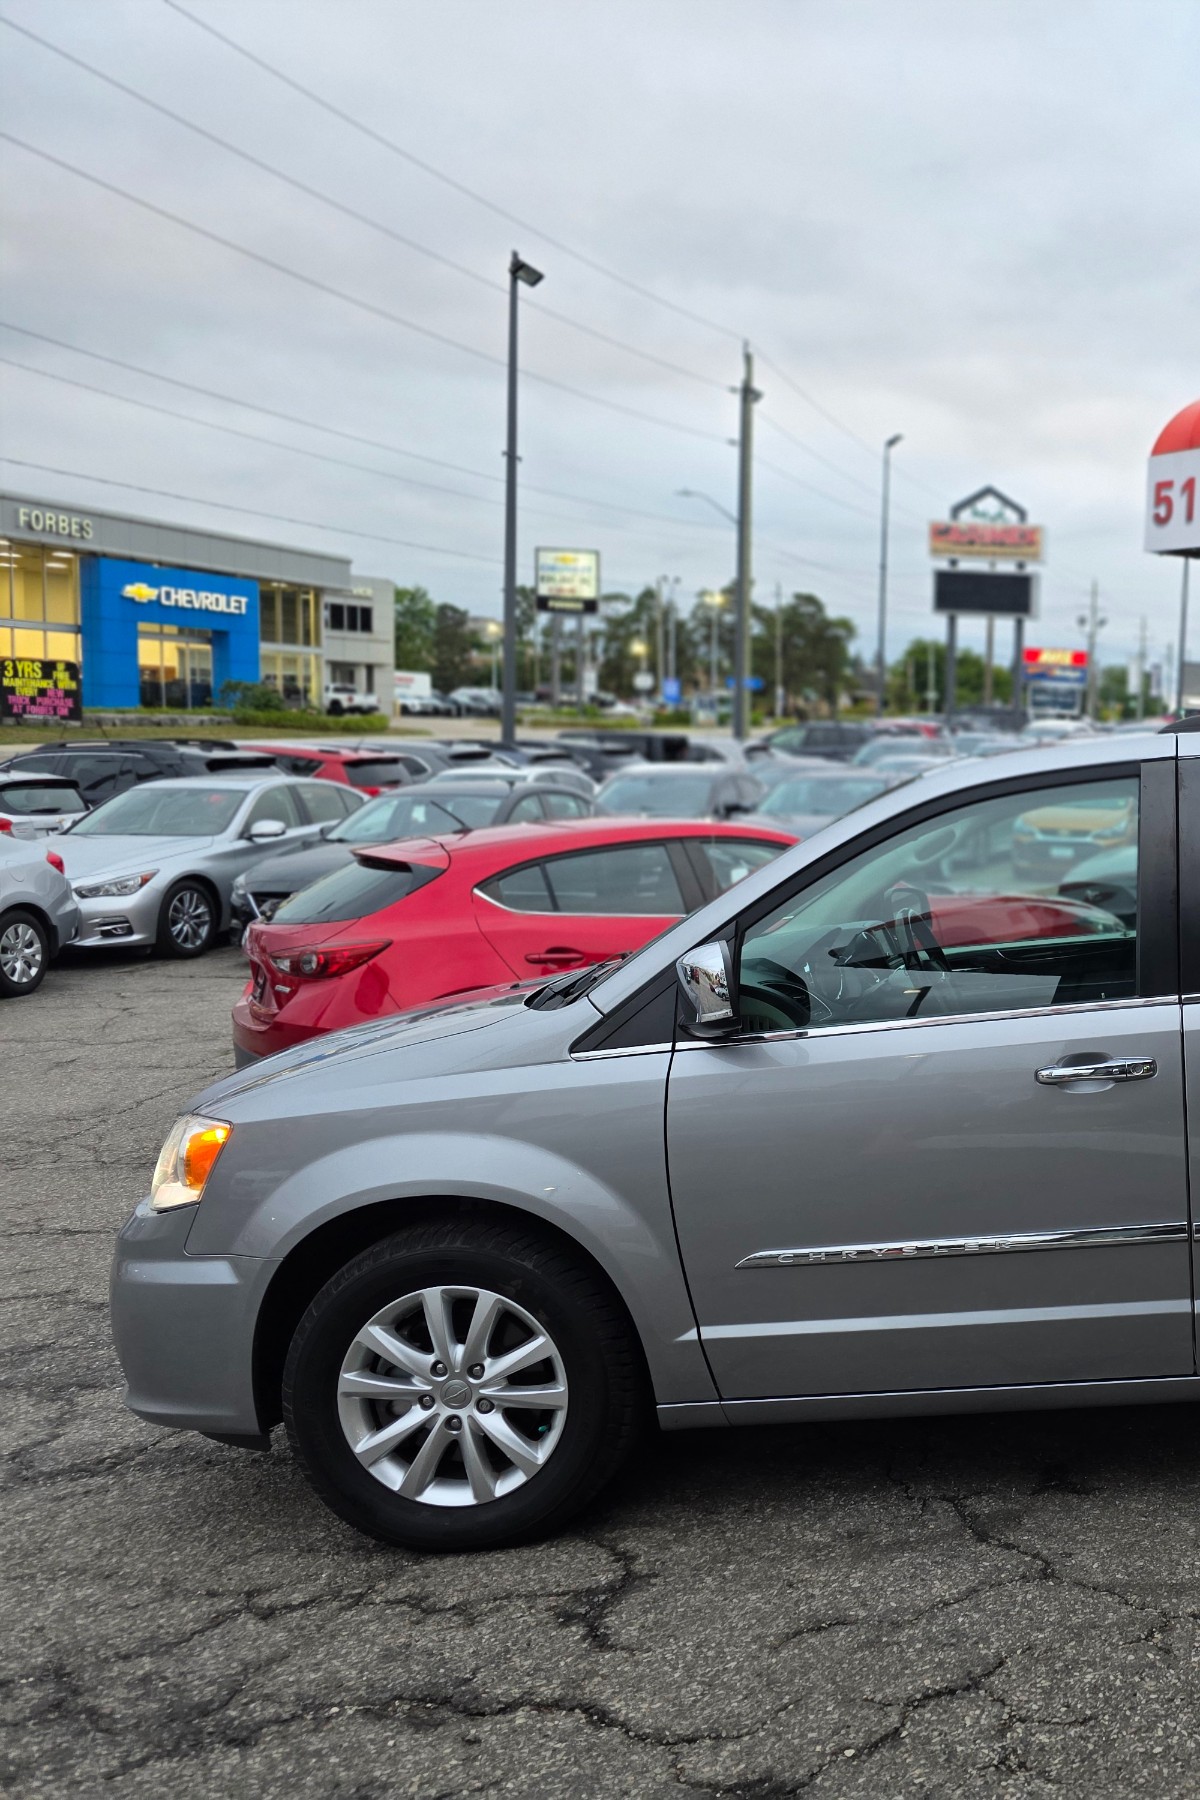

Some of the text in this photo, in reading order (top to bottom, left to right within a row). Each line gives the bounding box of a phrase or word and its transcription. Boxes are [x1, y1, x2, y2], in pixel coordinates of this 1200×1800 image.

[19, 507, 93, 539] FORBES
[160, 586, 248, 615] CHEVROLET
[4, 660, 13, 678] 3
[16, 660, 42, 678] YRS
[12, 704, 23, 714] AT
